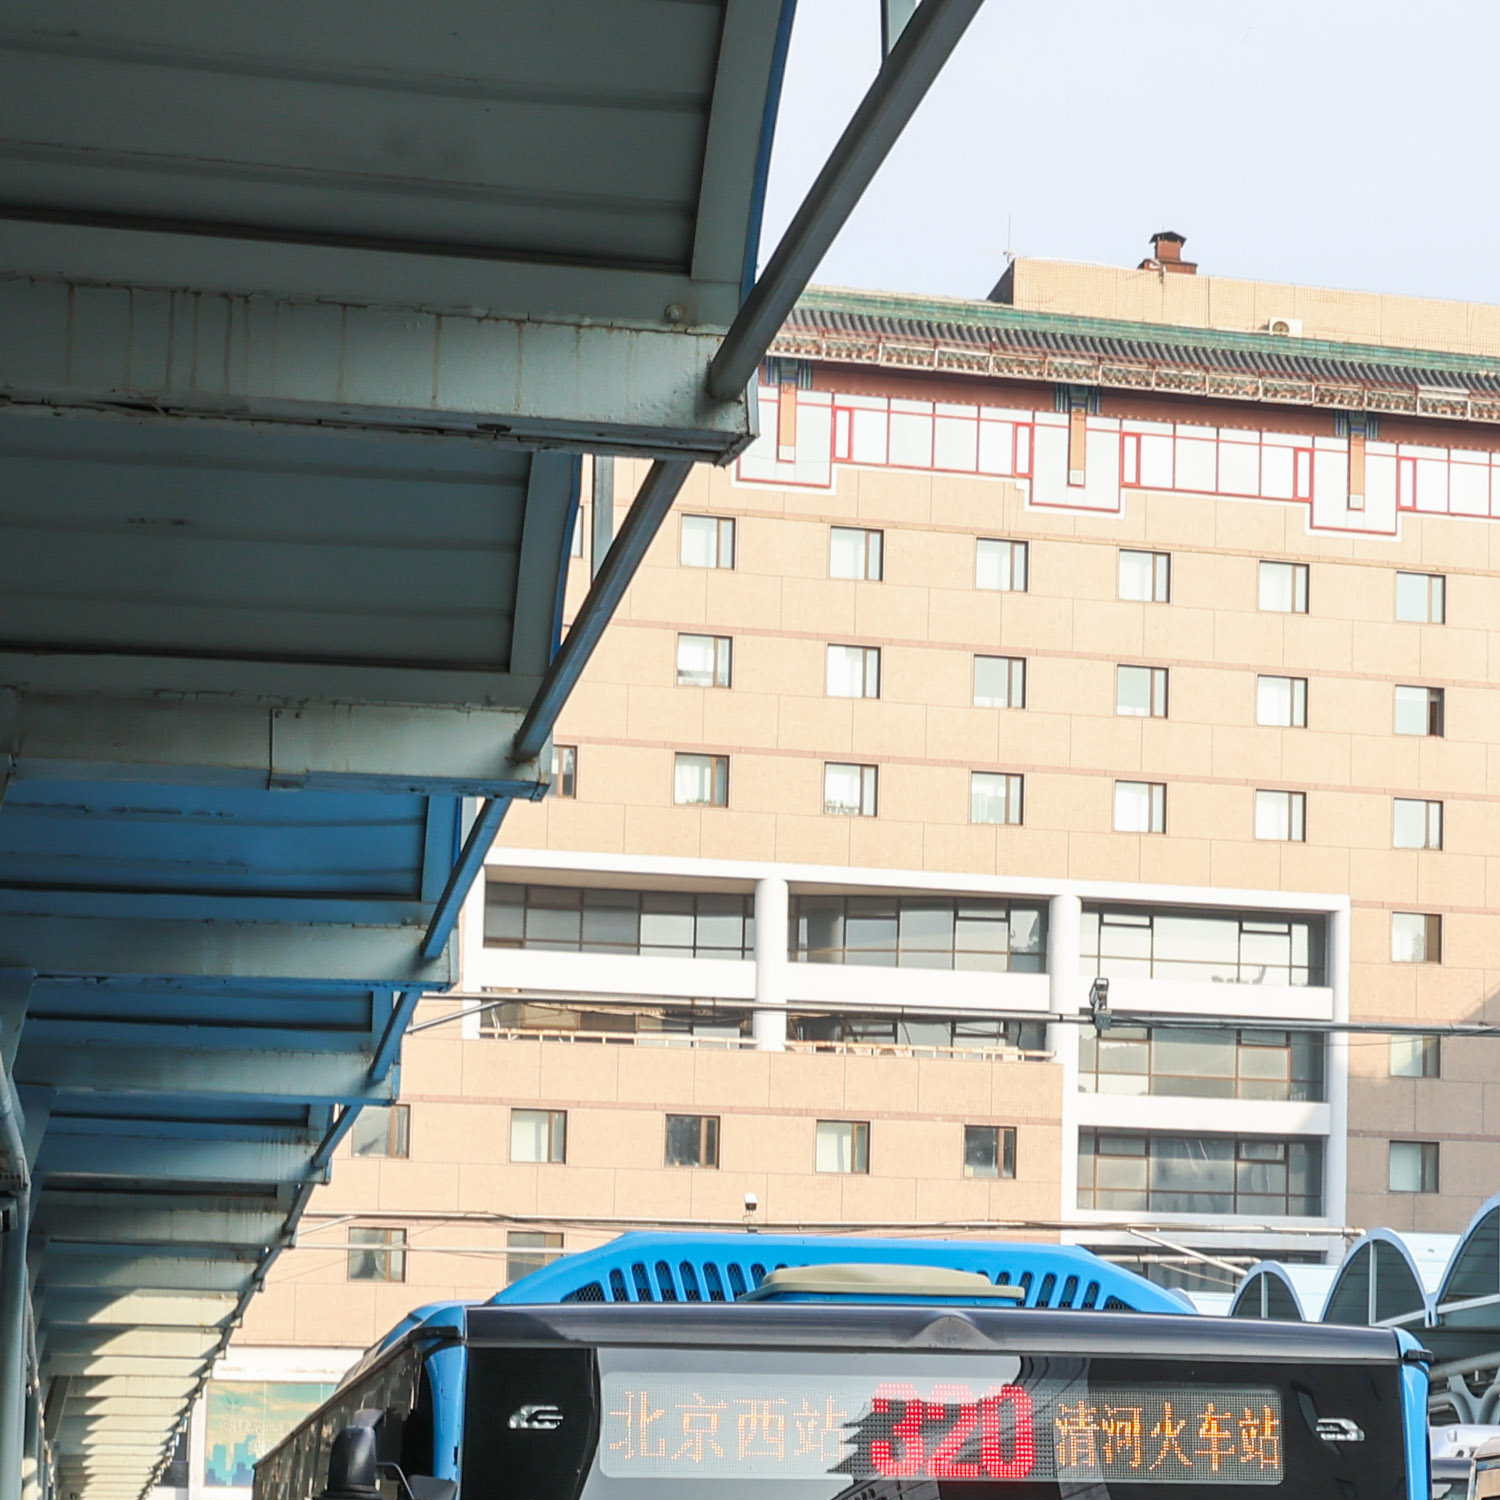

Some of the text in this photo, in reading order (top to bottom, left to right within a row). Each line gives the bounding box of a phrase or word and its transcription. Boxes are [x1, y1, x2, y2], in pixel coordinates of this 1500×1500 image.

[609, 1382, 1280, 1479] 北京西站 320 清河火车站
